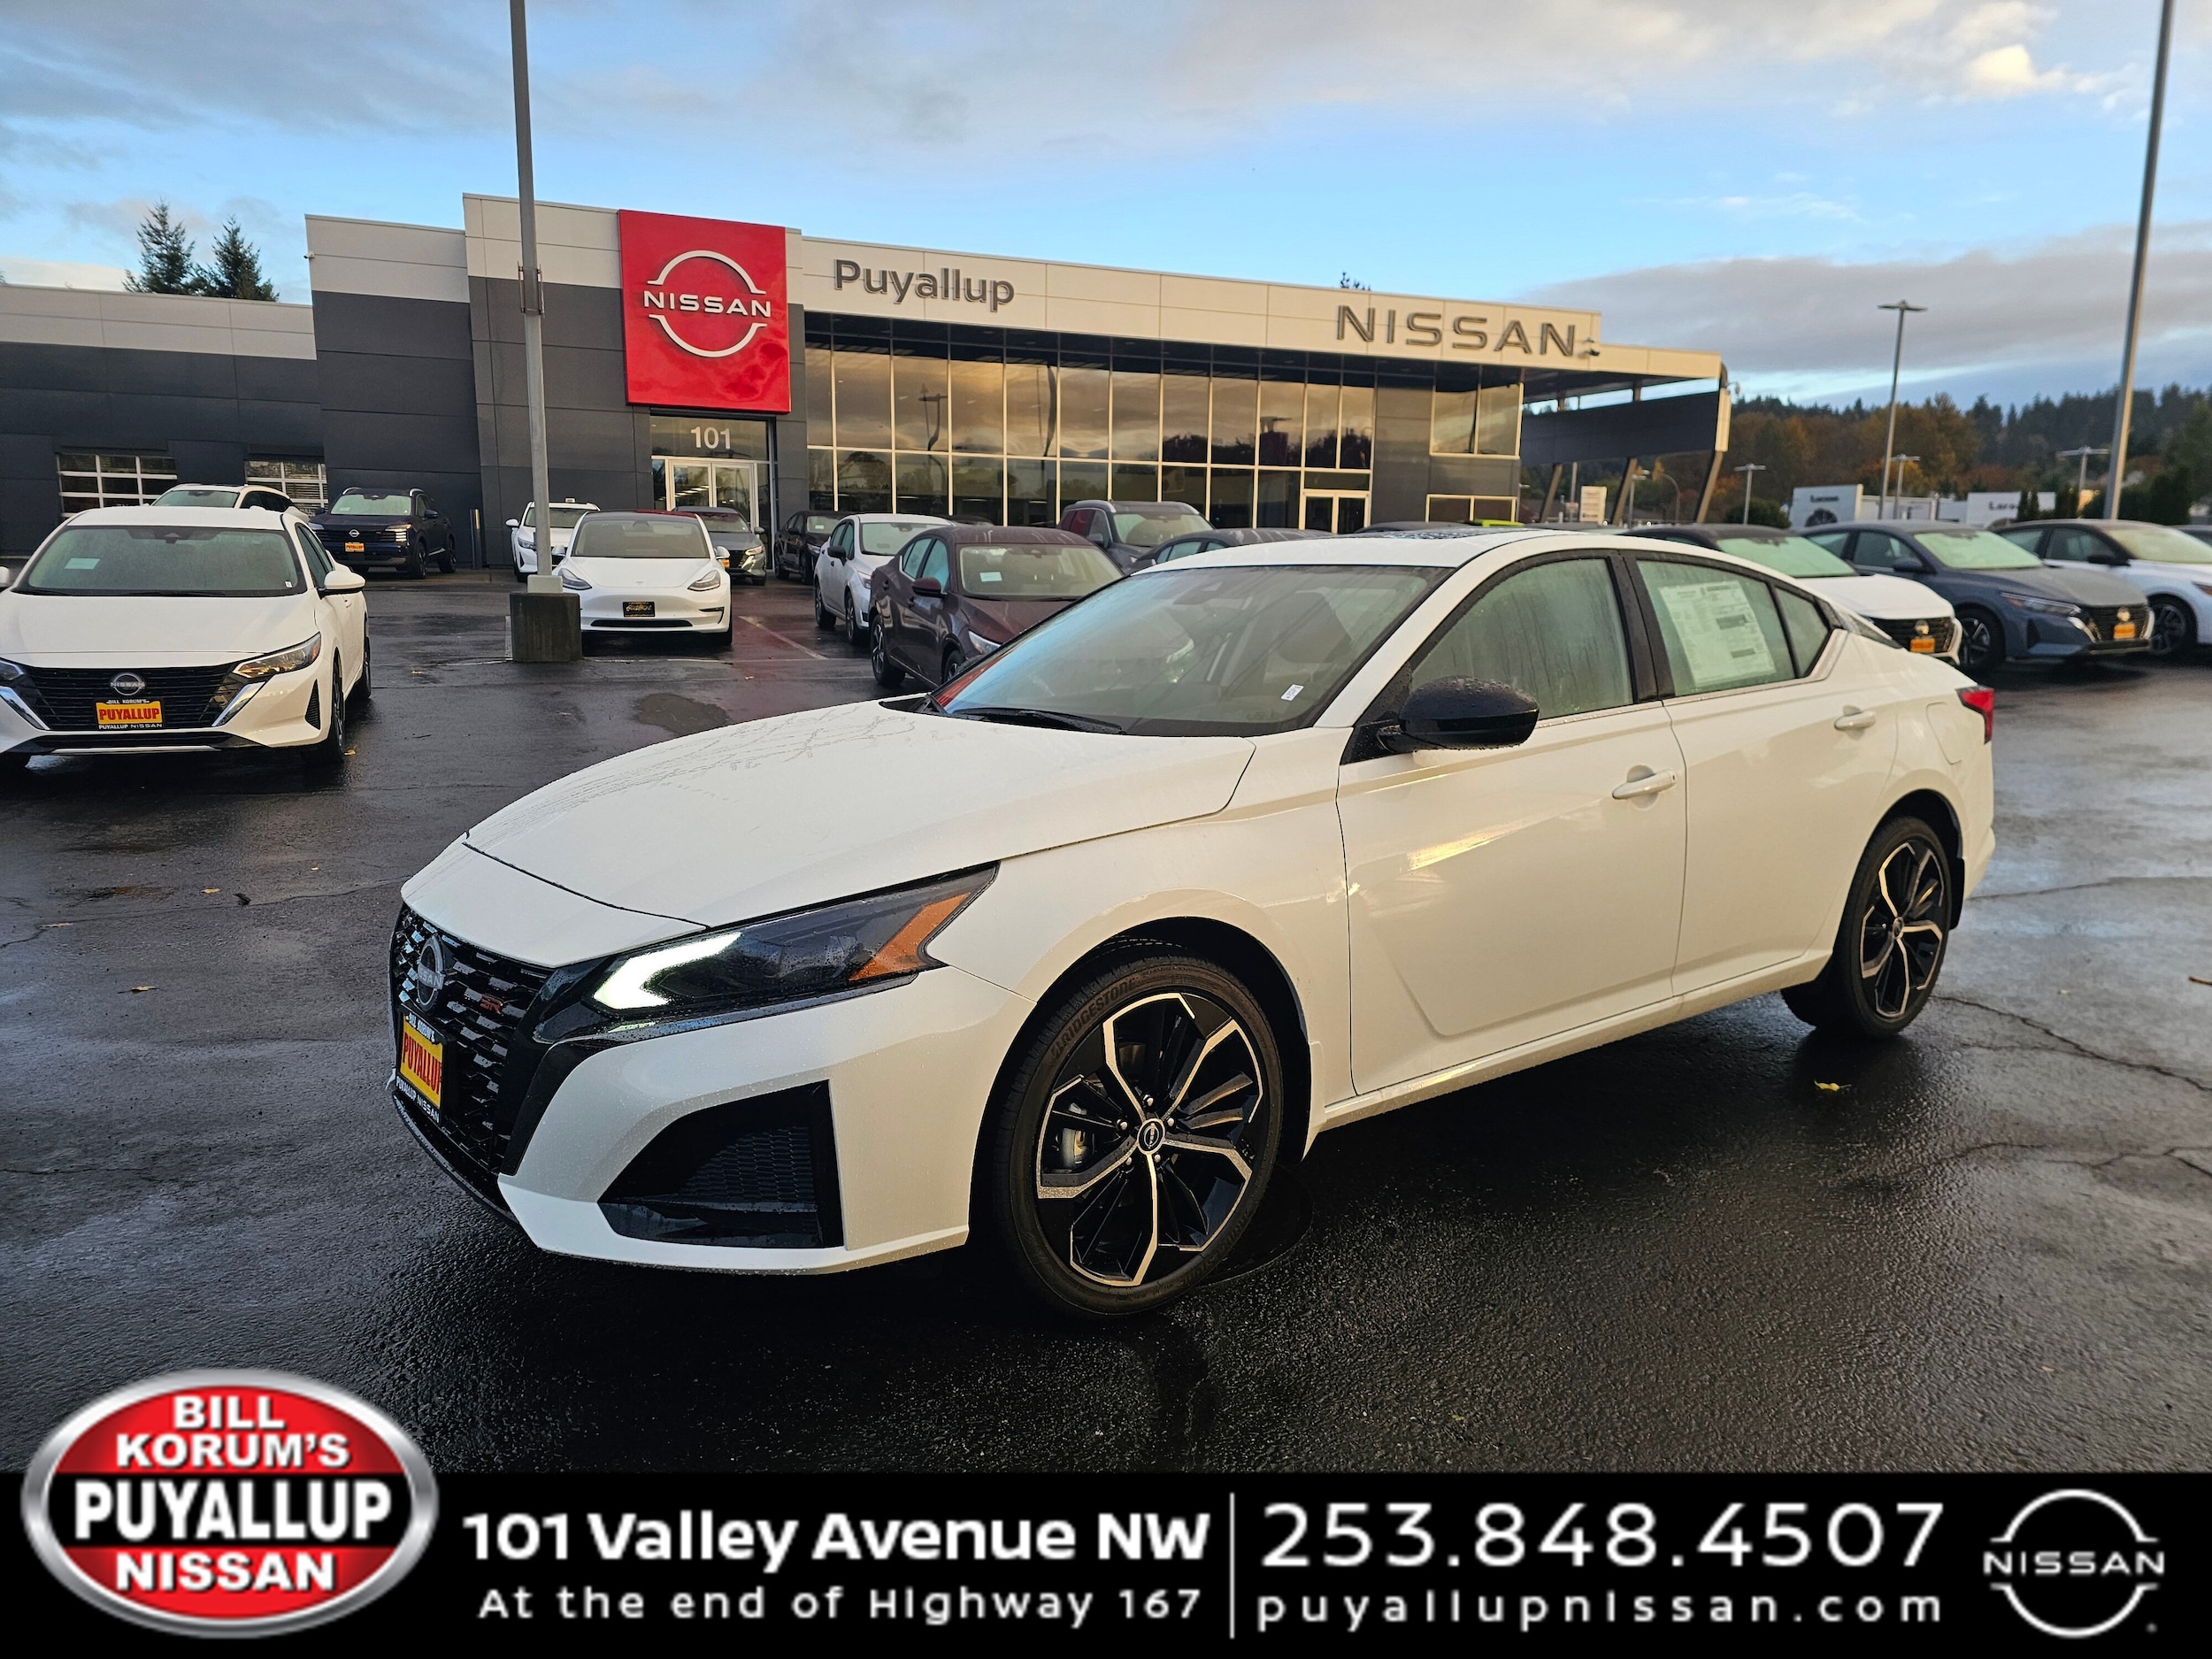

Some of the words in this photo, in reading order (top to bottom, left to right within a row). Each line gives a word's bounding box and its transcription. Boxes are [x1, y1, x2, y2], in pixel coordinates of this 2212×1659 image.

[834, 258, 1015, 312] Puyallup
[643, 289, 772, 318] NISSAN
[1337, 304, 1575, 357] NISSAN
[691, 426, 731, 449] 101
[98, 708, 159, 721] PUYALLUP
[1051, 976, 1137, 1058] BRIDGESTONE
[417, 1094, 440, 1124] NISSAN
